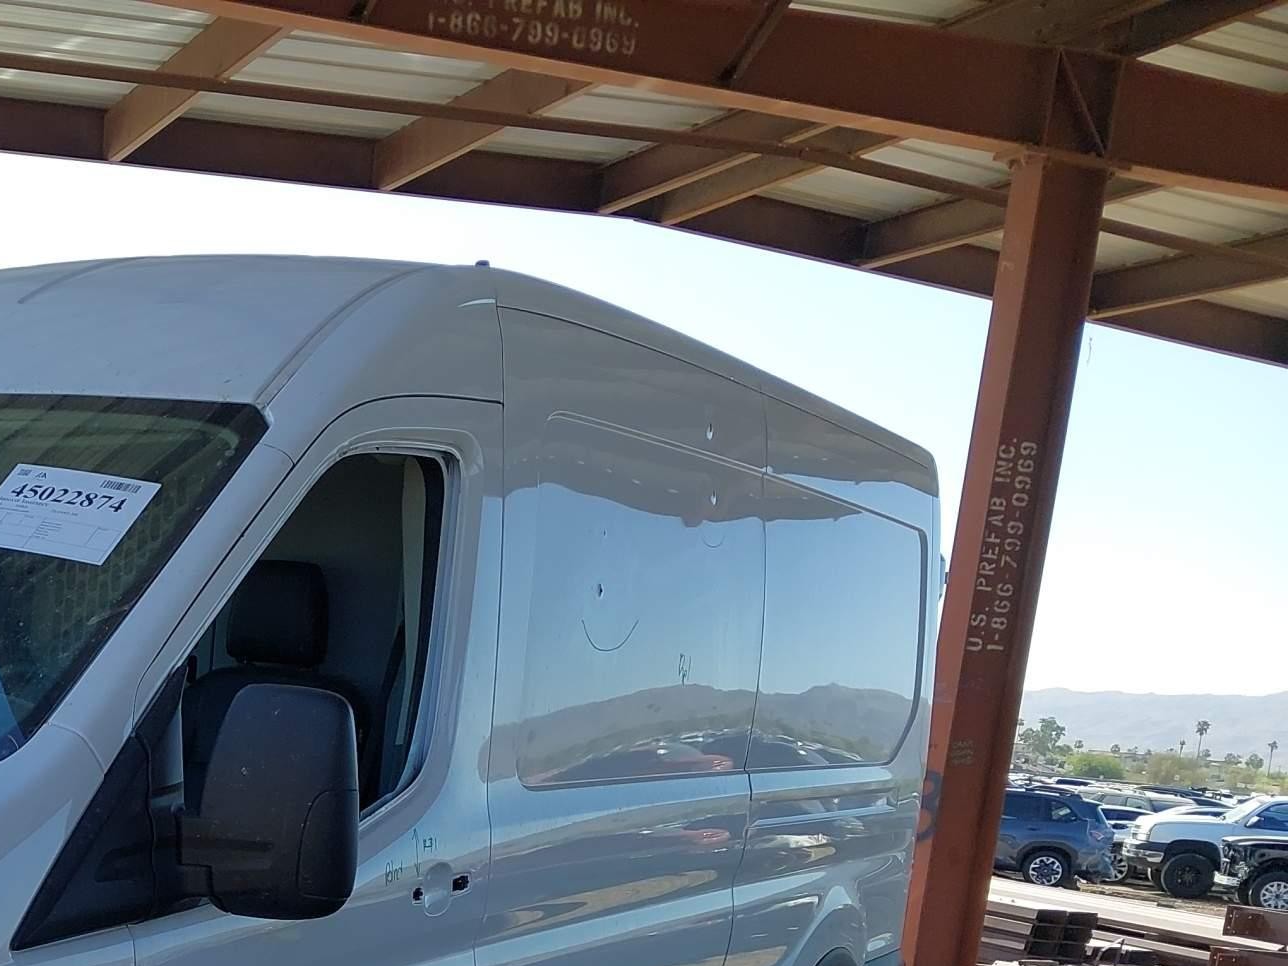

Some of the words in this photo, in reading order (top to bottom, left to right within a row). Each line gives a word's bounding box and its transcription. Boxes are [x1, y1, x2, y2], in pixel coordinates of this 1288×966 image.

[995, 437, 1018, 483] INC.
[11, 483, 128, 513] 45022874
[976, 497, 1007, 591] PREFAB
[986, 441, 1038, 651] 1-866-799-0969
[967, 607, 989, 651] U.S.
